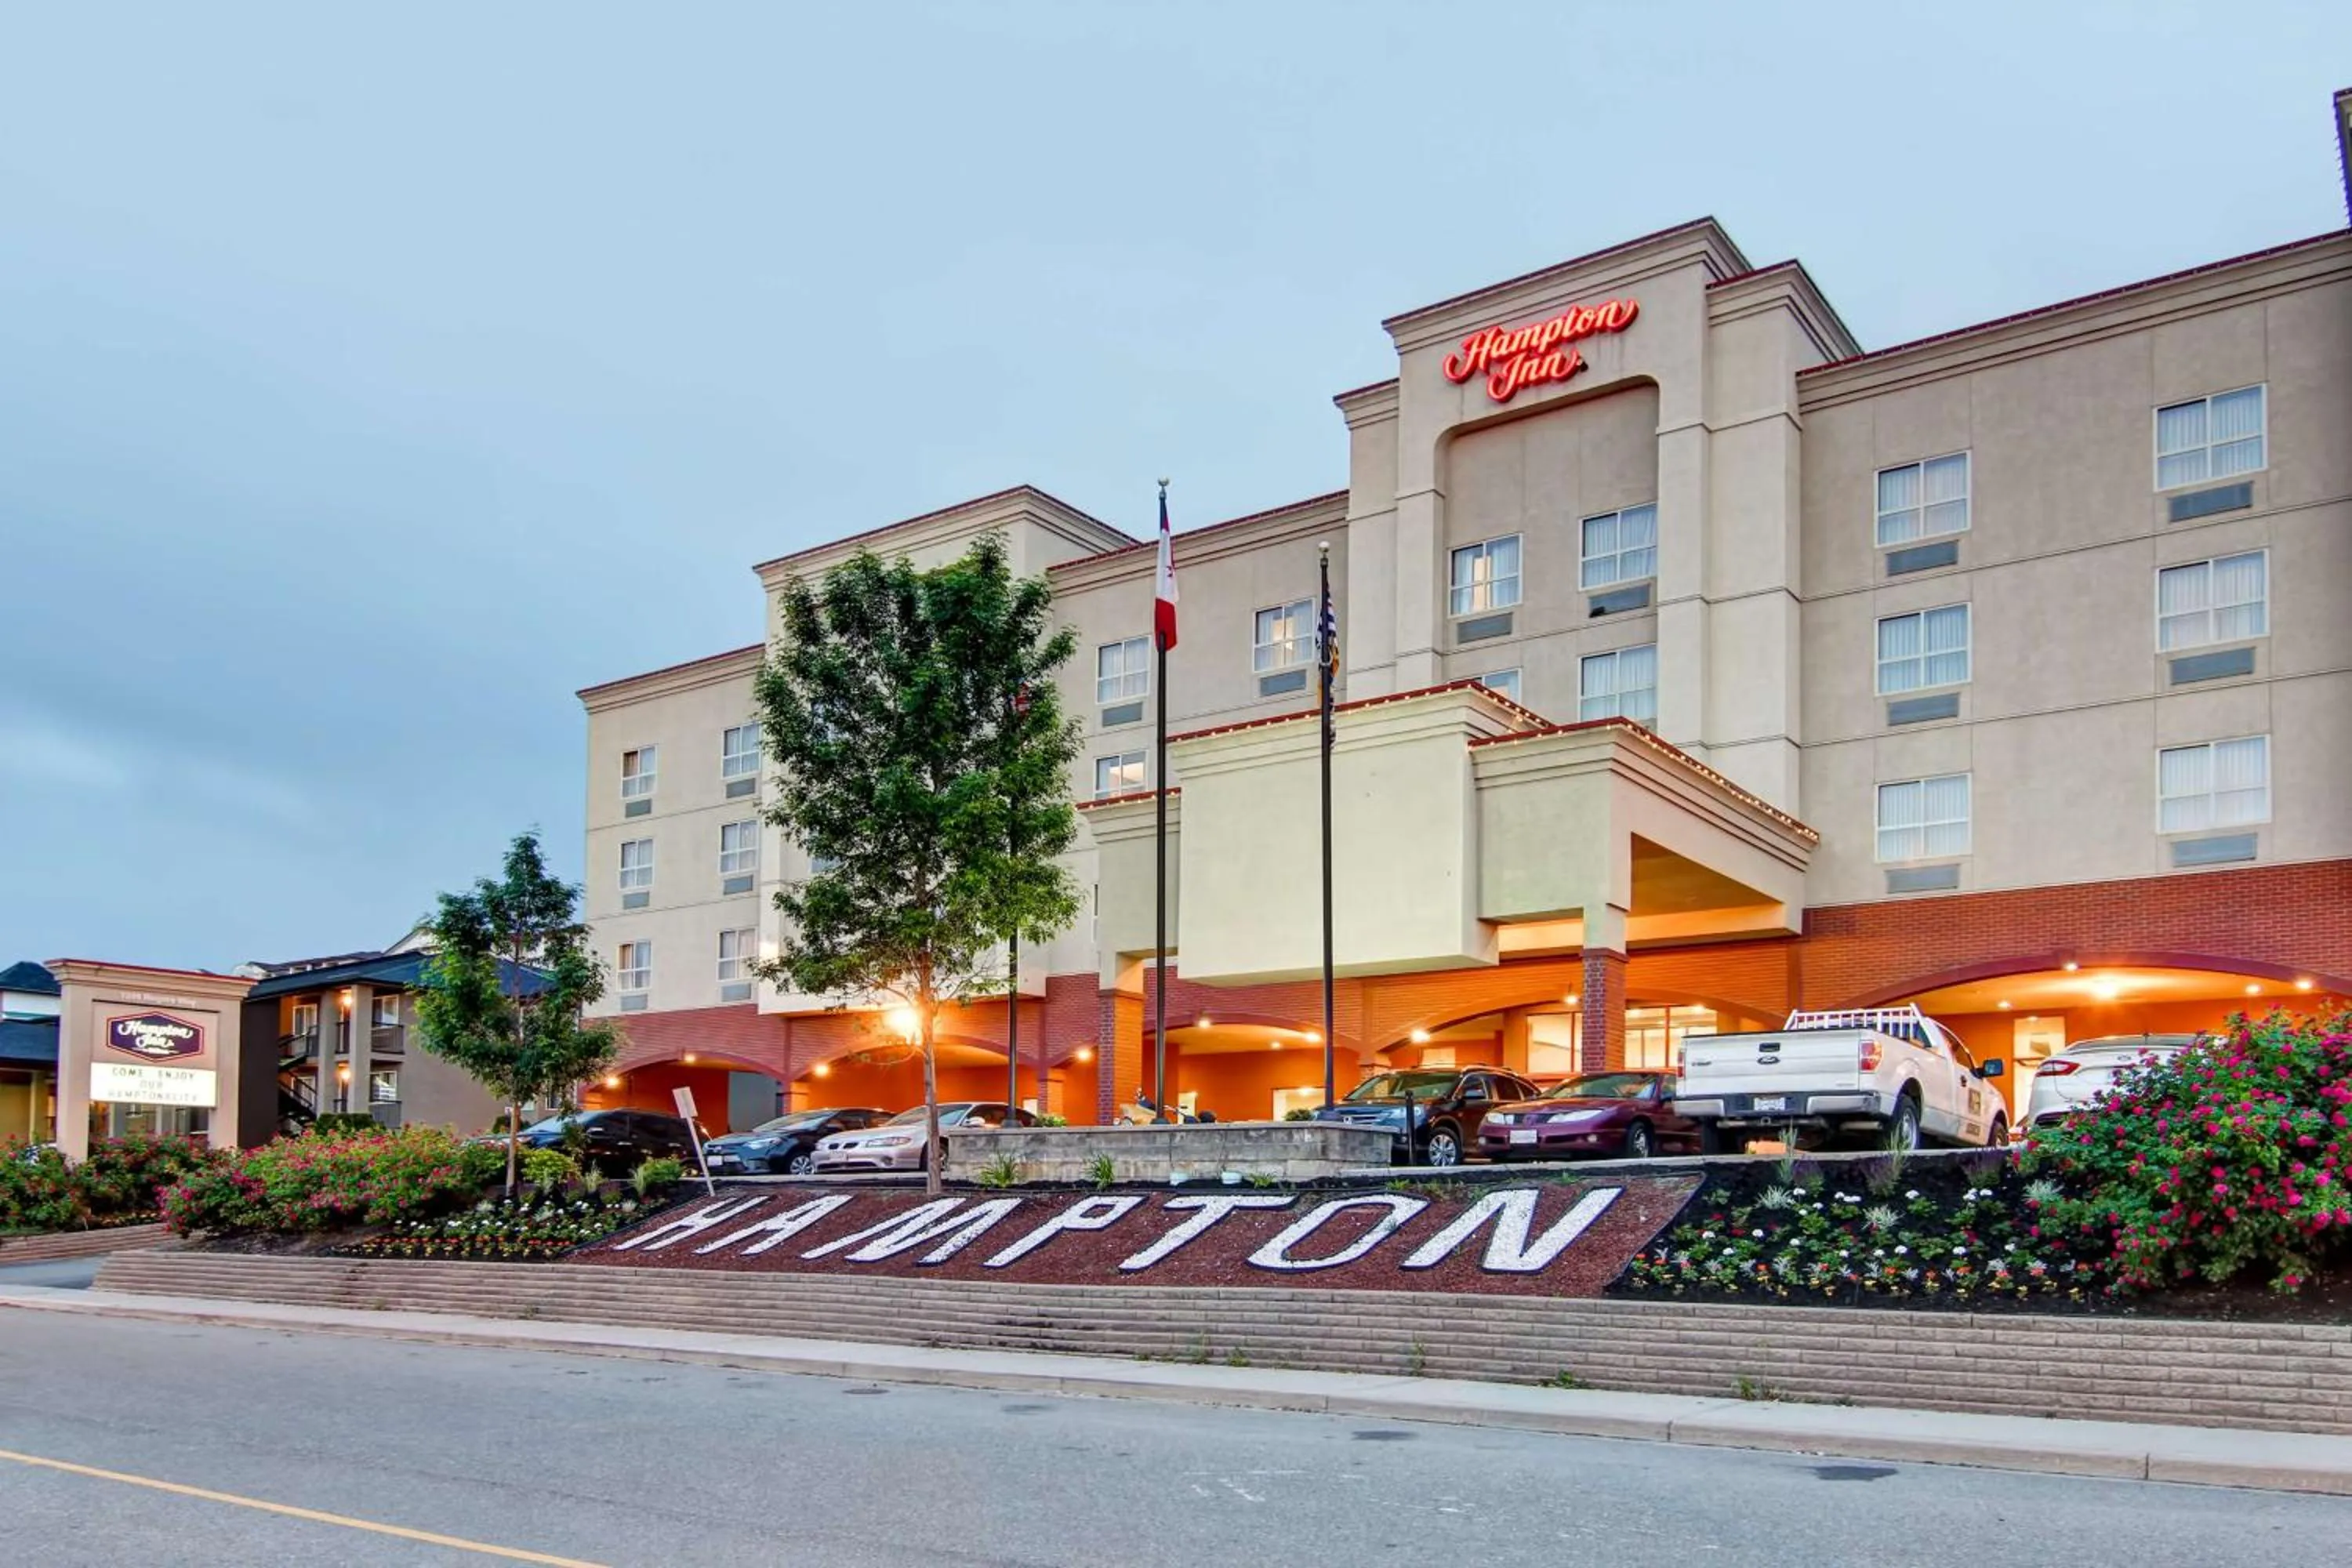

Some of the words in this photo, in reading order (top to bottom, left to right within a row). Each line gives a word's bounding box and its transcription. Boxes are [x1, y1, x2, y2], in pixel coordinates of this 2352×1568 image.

[1443, 299, 1639, 383] Hampton
[1486, 347, 1582, 404] Inn
[118, 1021, 193, 1038] Hampton
[135, 1034, 175, 1048] Inn
[113, 1068, 143, 1077] COME
[158, 1070, 195, 1080] ENJOY
[613, 1186, 1627, 1272] HAMPTON
